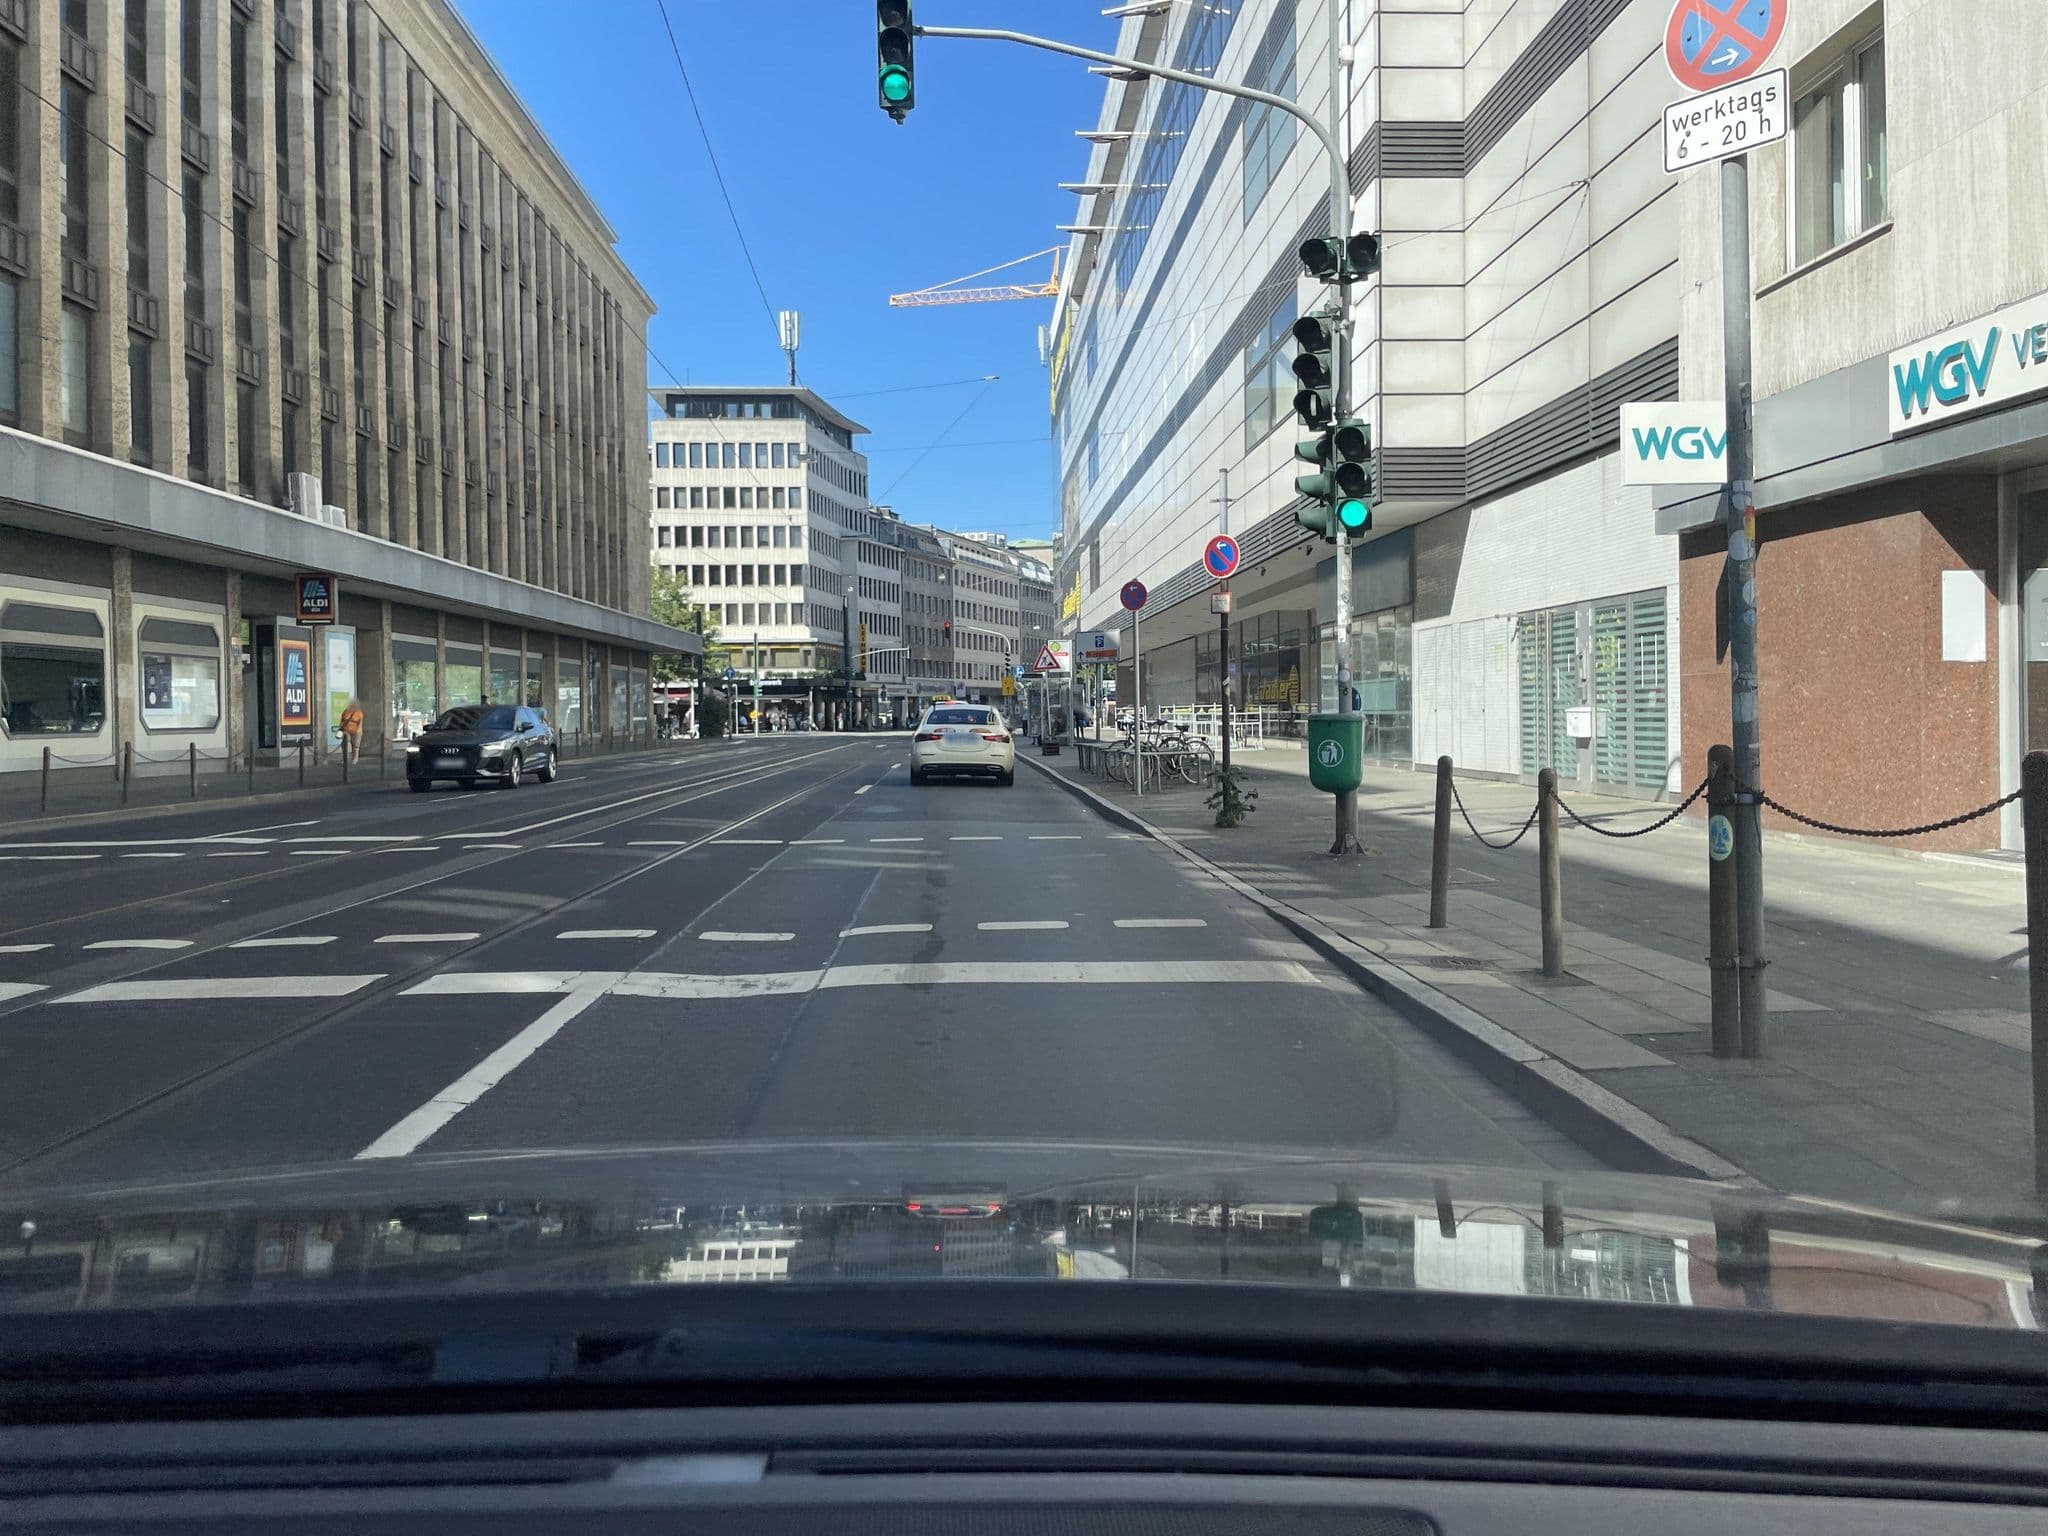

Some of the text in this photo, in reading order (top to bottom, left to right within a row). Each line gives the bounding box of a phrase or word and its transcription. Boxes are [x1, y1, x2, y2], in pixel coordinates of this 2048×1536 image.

[1672, 86, 1777, 132] werktags
[1677, 138, 1688, 159] 6
[1722, 120, 1746, 146] 20
[1760, 112, 1771, 134] h
[1894, 324, 2048, 418] WGV VE
[1632, 426, 1728, 460] WGV
[303, 599, 329, 607] ALDI
[286, 689, 306, 703] ALDI
